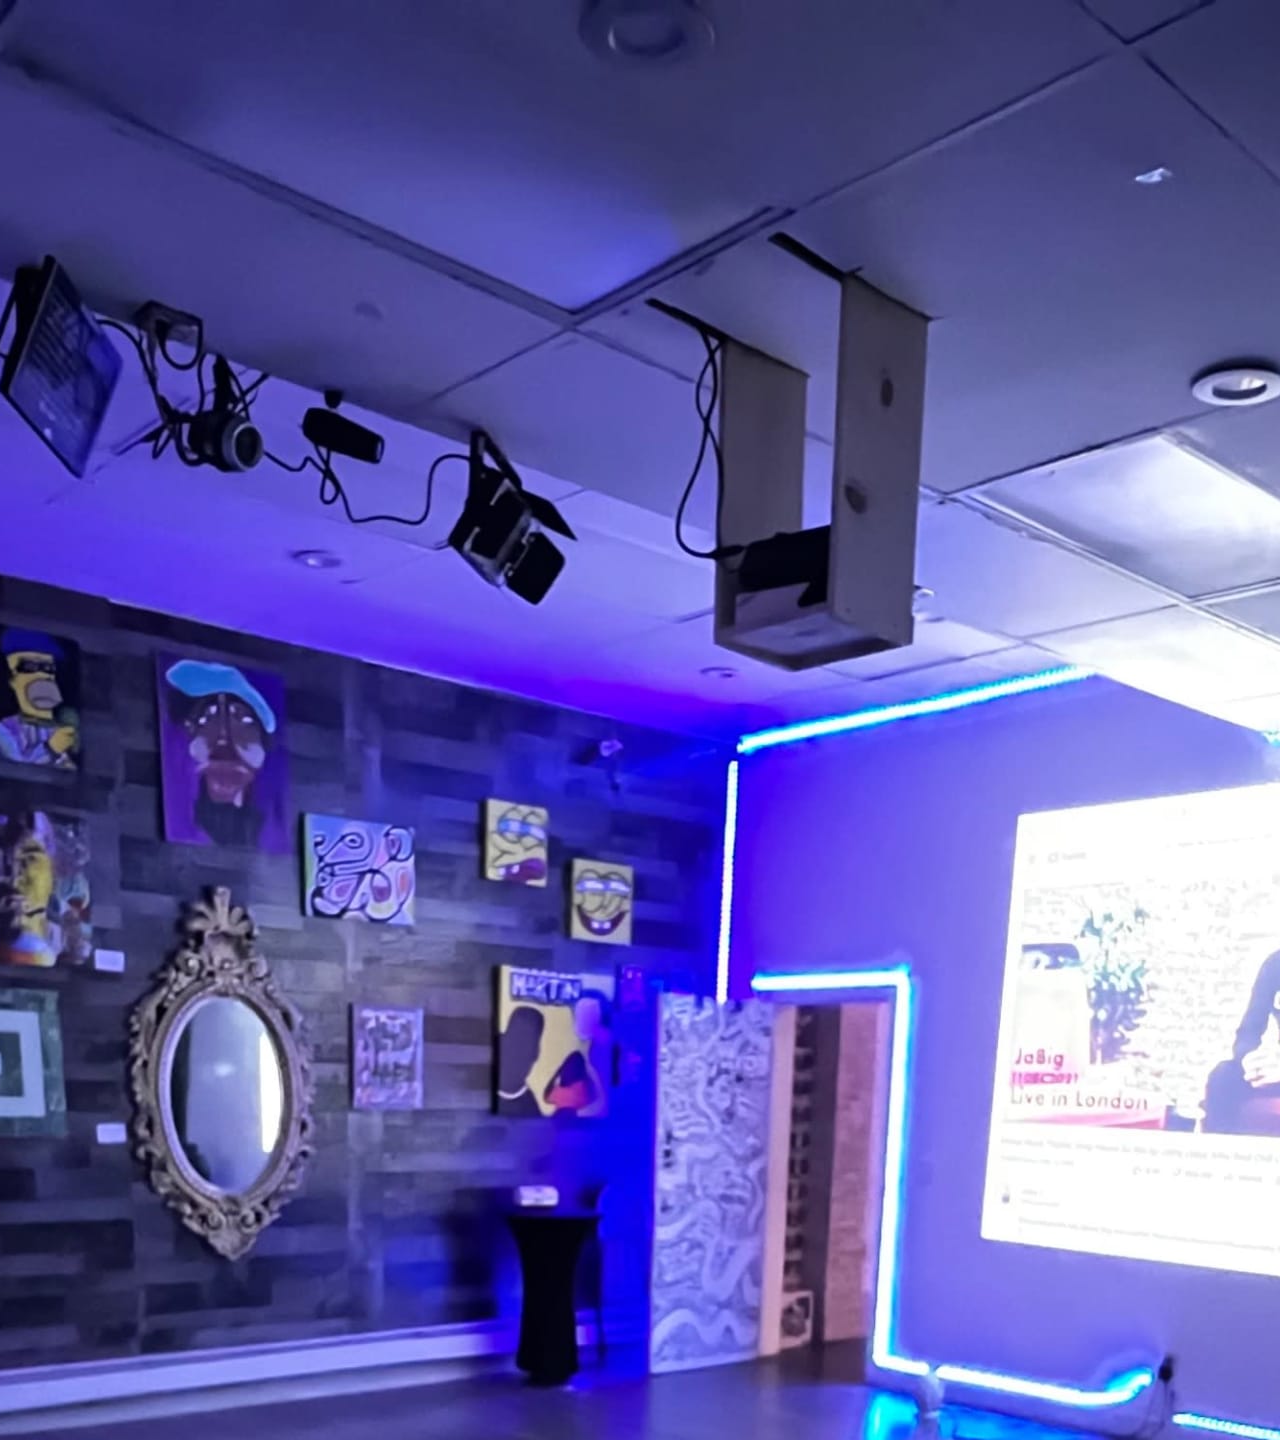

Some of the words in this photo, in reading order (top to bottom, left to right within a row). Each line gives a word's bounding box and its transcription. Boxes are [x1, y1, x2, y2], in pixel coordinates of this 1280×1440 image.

[1011, 1086, 1045, 1105] Live
[1051, 1092, 1068, 1107] in
[1075, 1090, 1149, 1111] London
